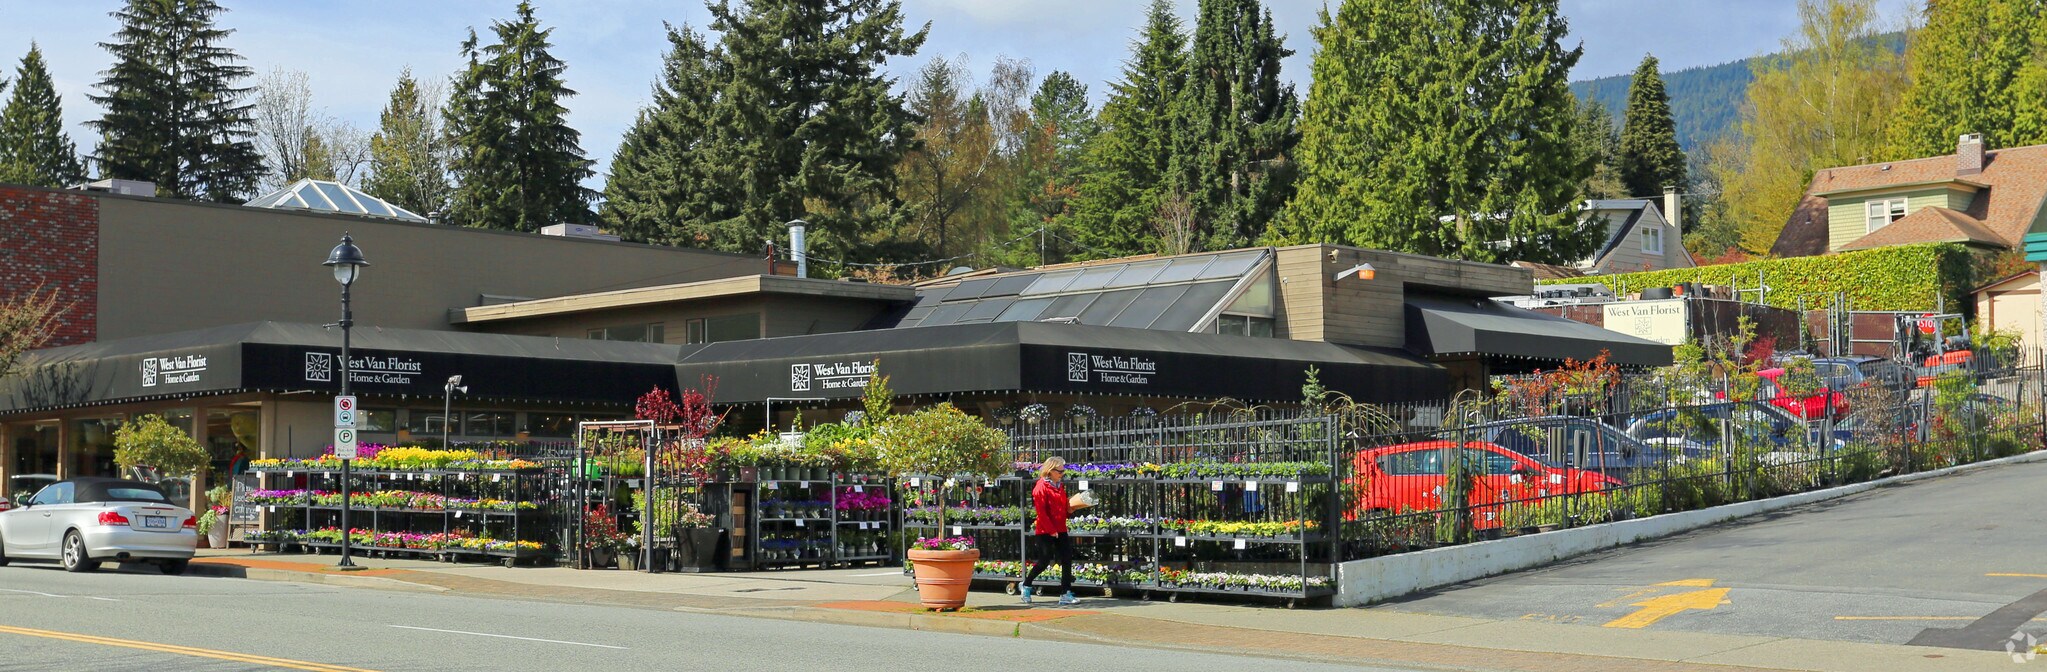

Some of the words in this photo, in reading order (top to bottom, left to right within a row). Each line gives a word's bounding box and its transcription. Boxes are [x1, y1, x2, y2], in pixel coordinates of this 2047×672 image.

[1608, 307, 1630, 317] West
[1631, 305, 1649, 316] Van
[1650, 304, 1680, 315] Florist
[159, 357, 175, 371] West
[174, 356, 187, 369] Van
[187, 354, 207, 368] Florist
[365, 356, 386, 370] Van
[387, 356, 422, 371] Florist
[813, 363, 835, 376] West
[834, 362, 851, 375] Van
[852, 360, 875, 374] Floris
[1091, 355, 1113, 369] West
[1113, 356, 1129, 370] Van
[1130, 357, 1156, 371] Florist
[165, 374, 179, 384] Home
[183, 371, 200, 383] Garden
[349, 372, 374, 383] Home
[374, 375, 381, 383] &
[381, 373, 411, 384] Garden
[822, 379, 841, 389] Home
[841, 380, 847, 388] &
[1101, 372, 1120, 383] Home
[1120, 375, 1126, 383] &
[1125, 373, 1148, 384] Garden
[343, 432, 350, 440] P
